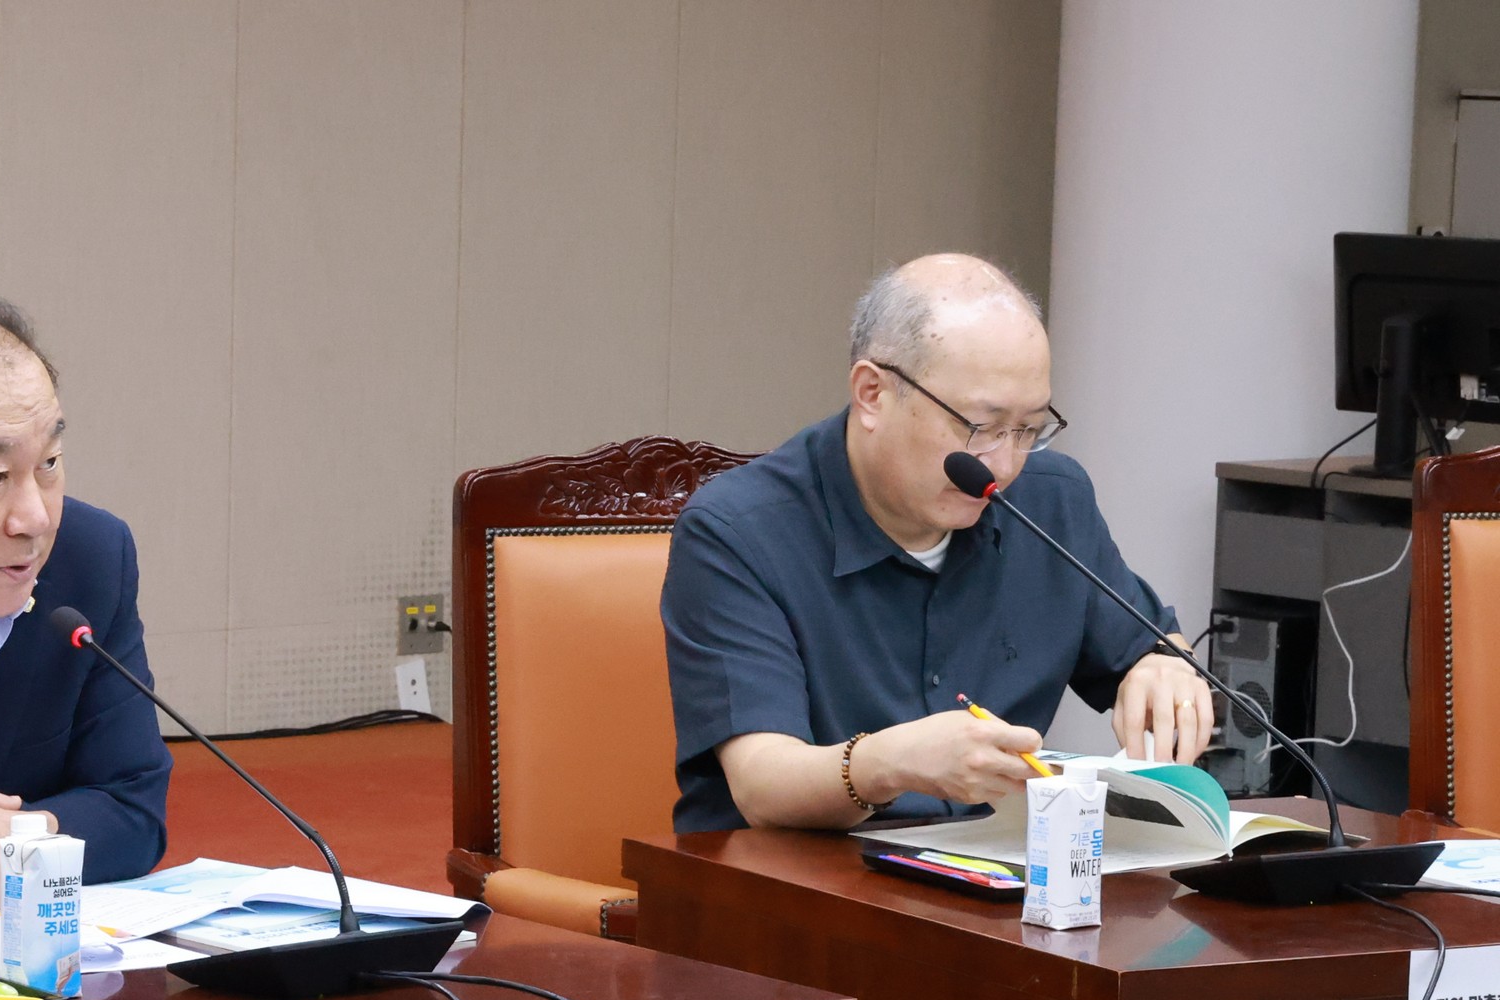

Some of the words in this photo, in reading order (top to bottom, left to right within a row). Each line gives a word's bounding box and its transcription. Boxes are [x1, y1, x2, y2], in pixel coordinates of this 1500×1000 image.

[1070, 848, 1088, 860] DEEP
[37, 902, 75, 918] 깨끗한
[44, 919, 78, 936] 주세요
